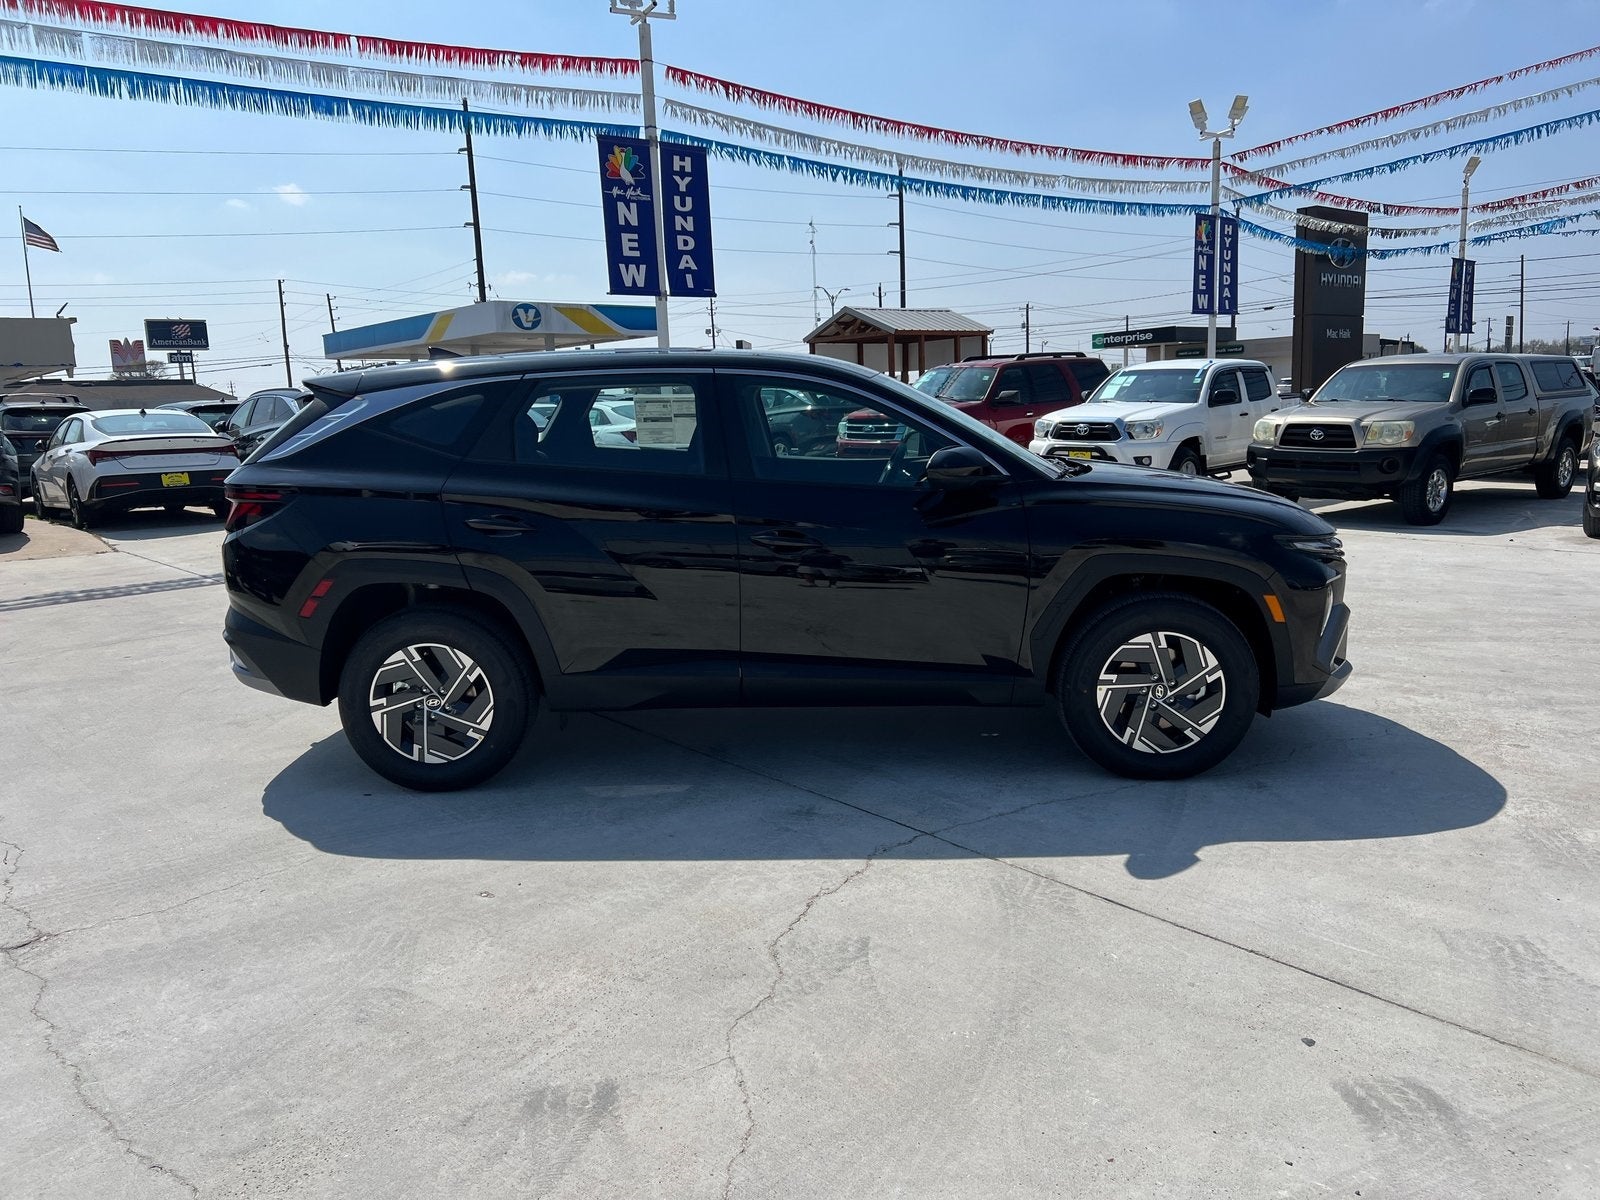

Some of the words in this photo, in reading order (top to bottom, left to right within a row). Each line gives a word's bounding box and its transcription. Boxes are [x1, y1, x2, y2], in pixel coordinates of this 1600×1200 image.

[672, 155, 698, 289] HYUNDAI
[616, 201, 647, 288] NEW
[1197, 254, 1209, 310] NEW
[1222, 224, 1233, 310] HYUNDAI
[1320, 272, 1362, 288] HYUNDAI
[1448, 288, 1457, 330] NEW
[1463, 265, 1473, 329] HYUNDAI
[151, 338, 207, 346] AmericanBank
[1093, 331, 1154, 345] enterprise
[1326, 328, 1339, 339] Mac
[1339, 328, 1352, 339] Haik
[171, 354, 191, 362] atm
